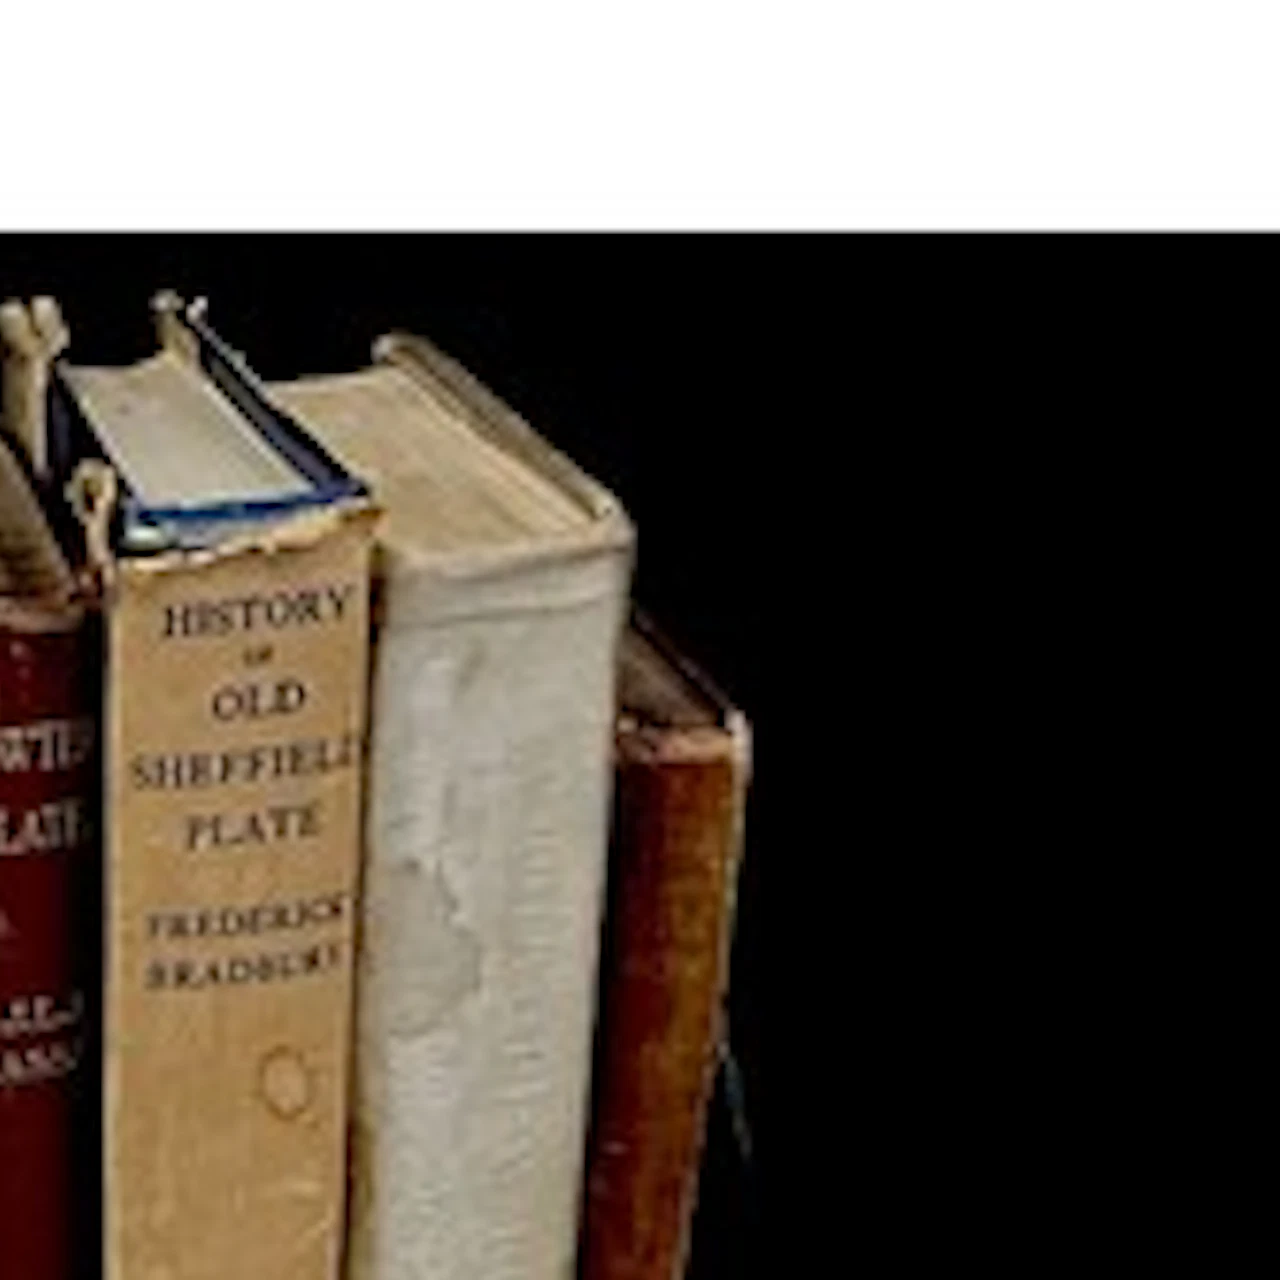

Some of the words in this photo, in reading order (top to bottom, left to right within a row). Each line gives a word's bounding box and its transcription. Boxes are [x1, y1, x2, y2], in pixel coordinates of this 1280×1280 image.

[161, 584, 356, 639] HISTORY
[211, 681, 307, 724] OLD
[185, 807, 323, 851] PLATE
